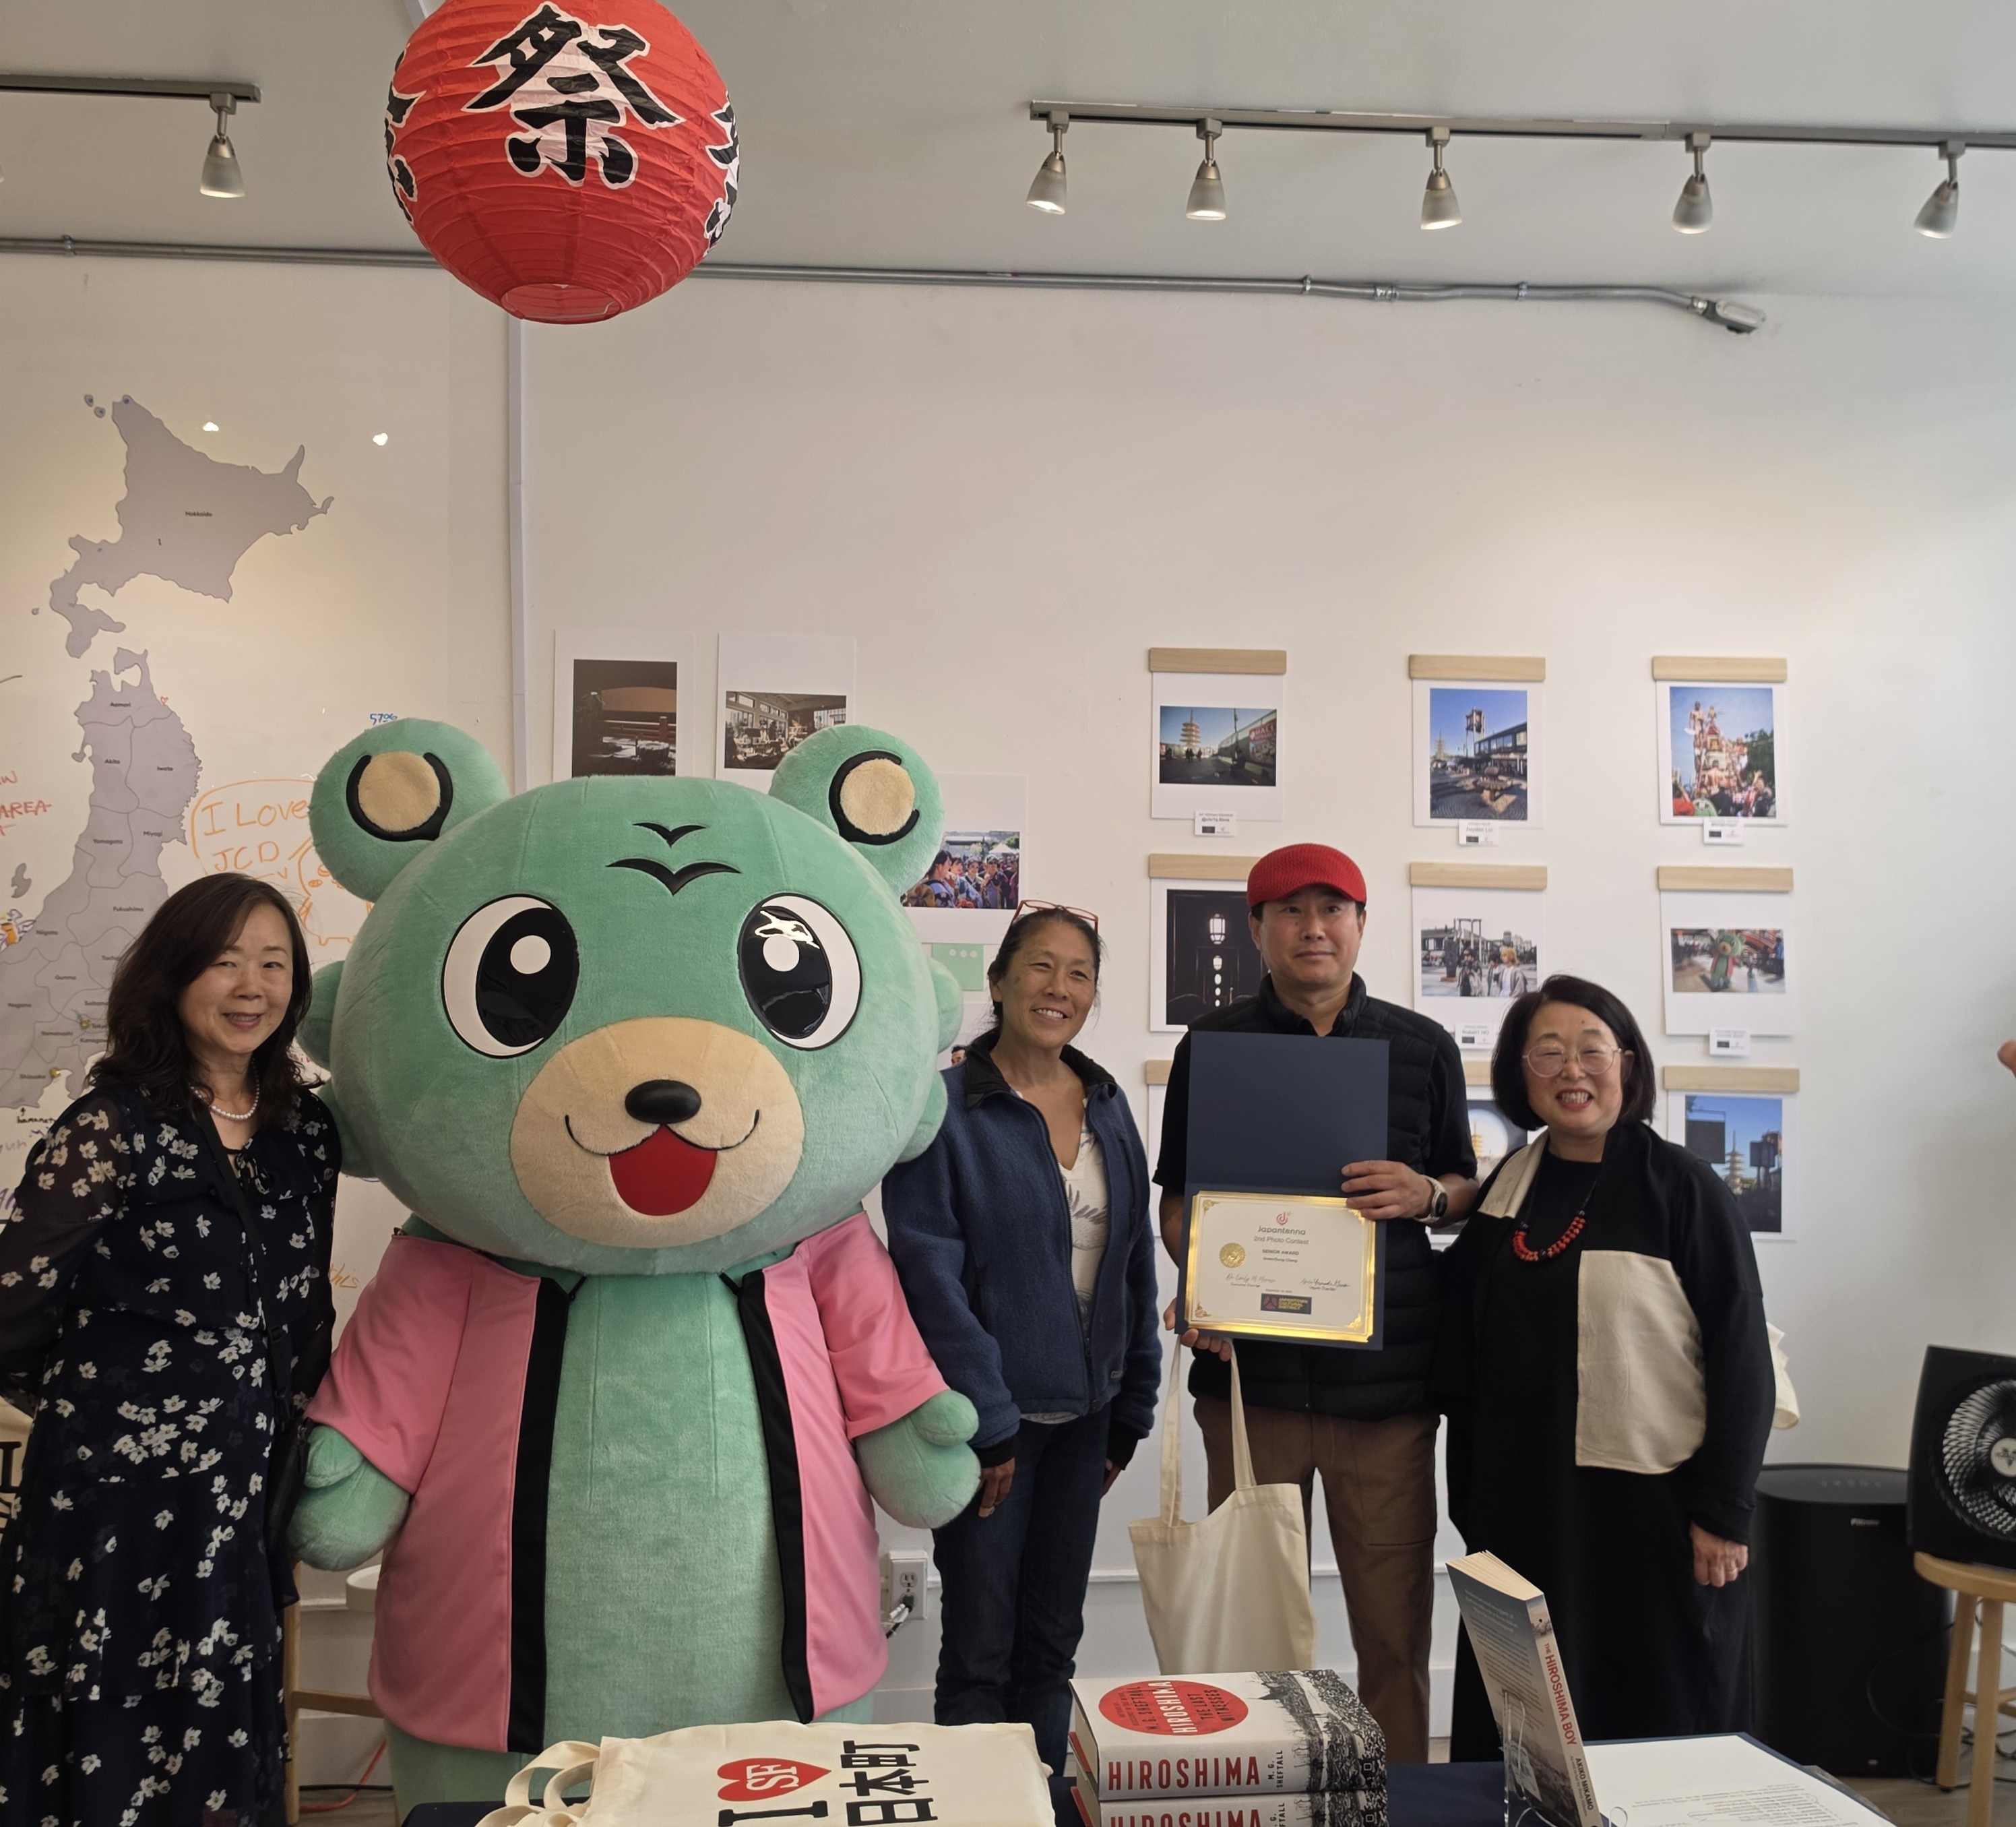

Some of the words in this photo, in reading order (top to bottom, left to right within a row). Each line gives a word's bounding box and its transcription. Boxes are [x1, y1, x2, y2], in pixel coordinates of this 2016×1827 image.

[464, 3, 683, 189] 祭
[201, 801, 226, 836] I
[1257, 1225, 1306, 1235] Japantenna
[1286, 1237, 1310, 1245] Contest
[1127, 1686, 1153, 1714] SHEFTALL
[1147, 1681, 1198, 1733] HIROSHIMA
[1187, 1693, 1208, 1707] LAST
[1203, 1689, 1236, 1722] WITNESSES
[1545, 1653, 1570, 1723] HIROSHIMA
[1562, 1721, 1577, 1745] BOY
[1196, 1708, 1215, 1721] THE
[746, 1764, 800, 1792] SF
[1108, 1756, 1260, 1791] HIROSHIMA
[1267, 1760, 1275, 1770] G.
[1267, 1770, 1275, 1780] M.
[1275, 1750, 1284, 1789] SHEFTALL
[840, 1740, 939, 1827] 日本町
[1575, 1757, 1586, 1780] AKIKO
[1581, 1780, 1594, 1811] MIKAMO
[718, 1800, 829, 1827] I
